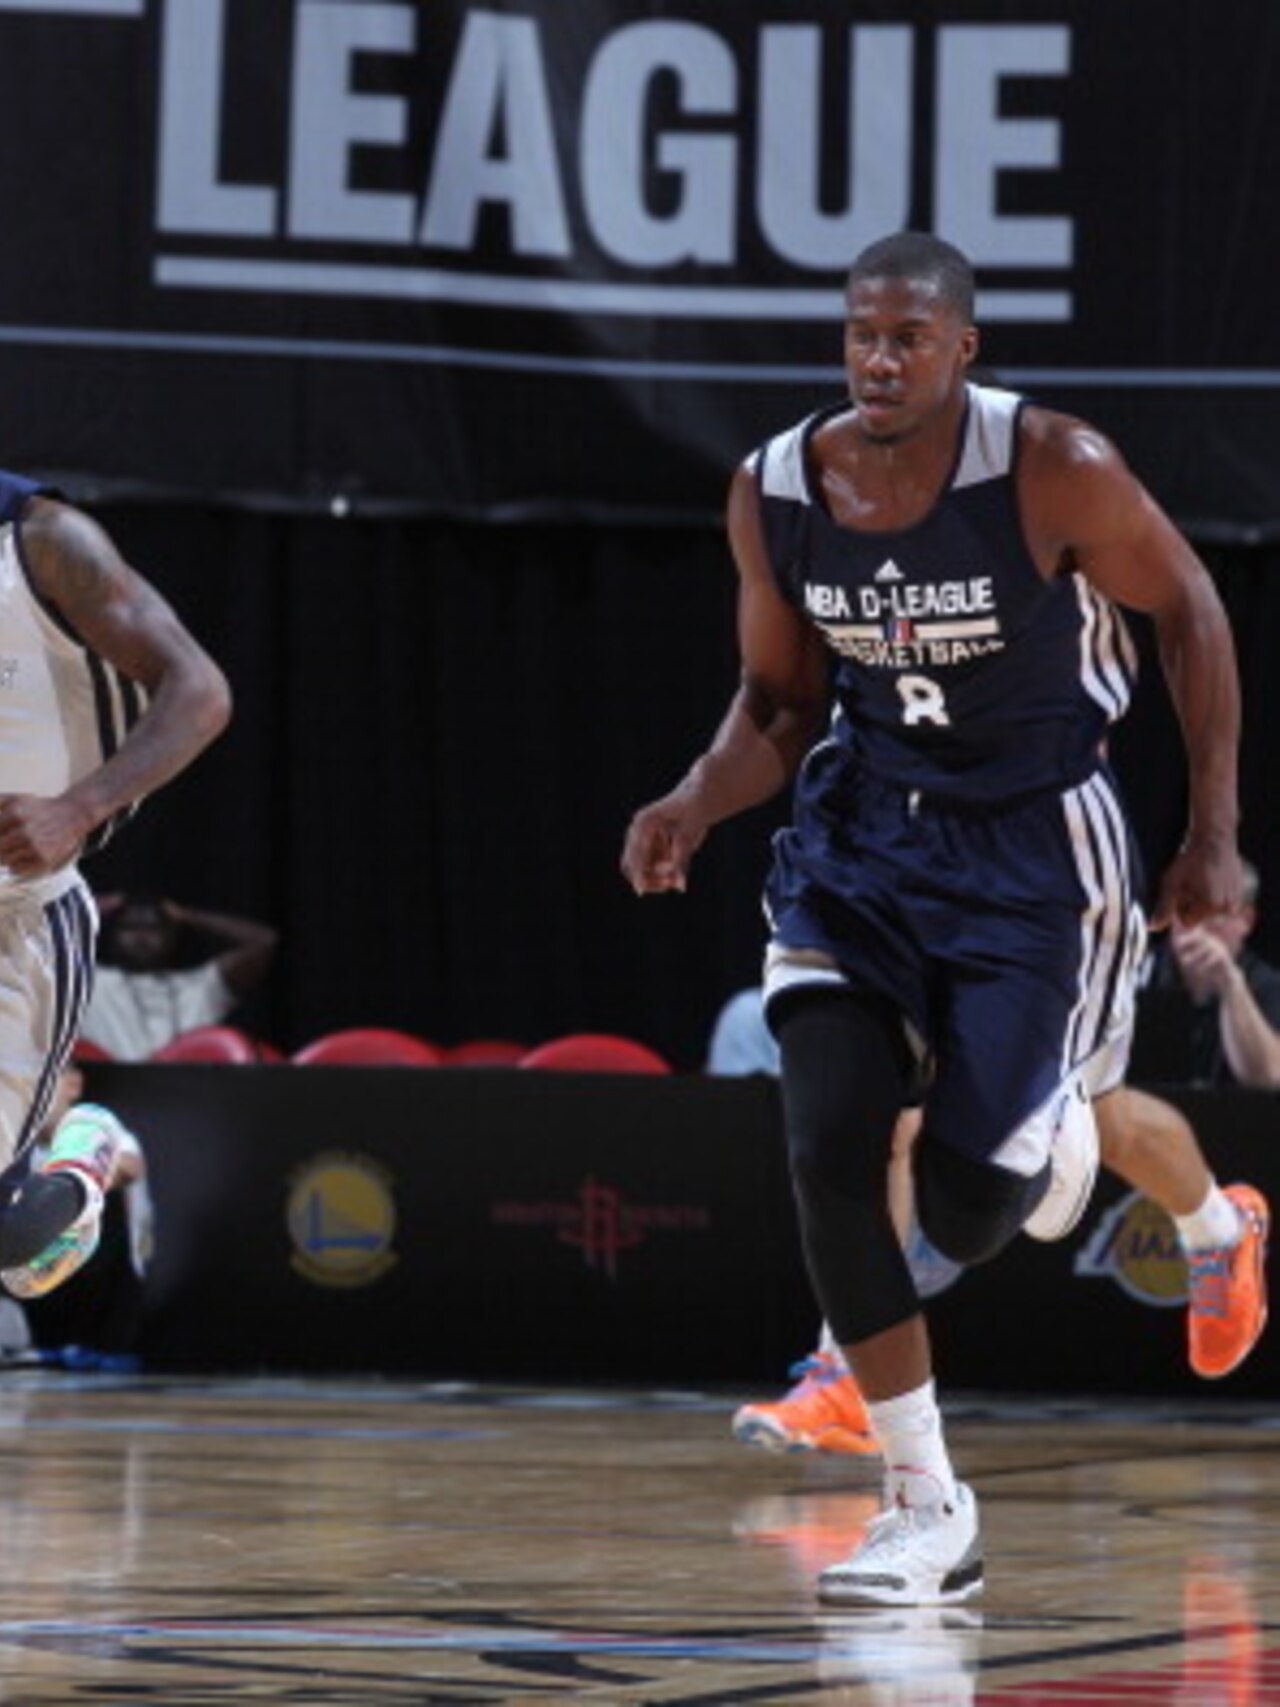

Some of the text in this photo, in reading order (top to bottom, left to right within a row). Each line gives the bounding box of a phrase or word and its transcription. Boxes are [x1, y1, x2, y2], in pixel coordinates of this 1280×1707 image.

[156, 0, 1073, 269] LEAGUE
[803, 577, 996, 618] NBA D-LEAGUE
